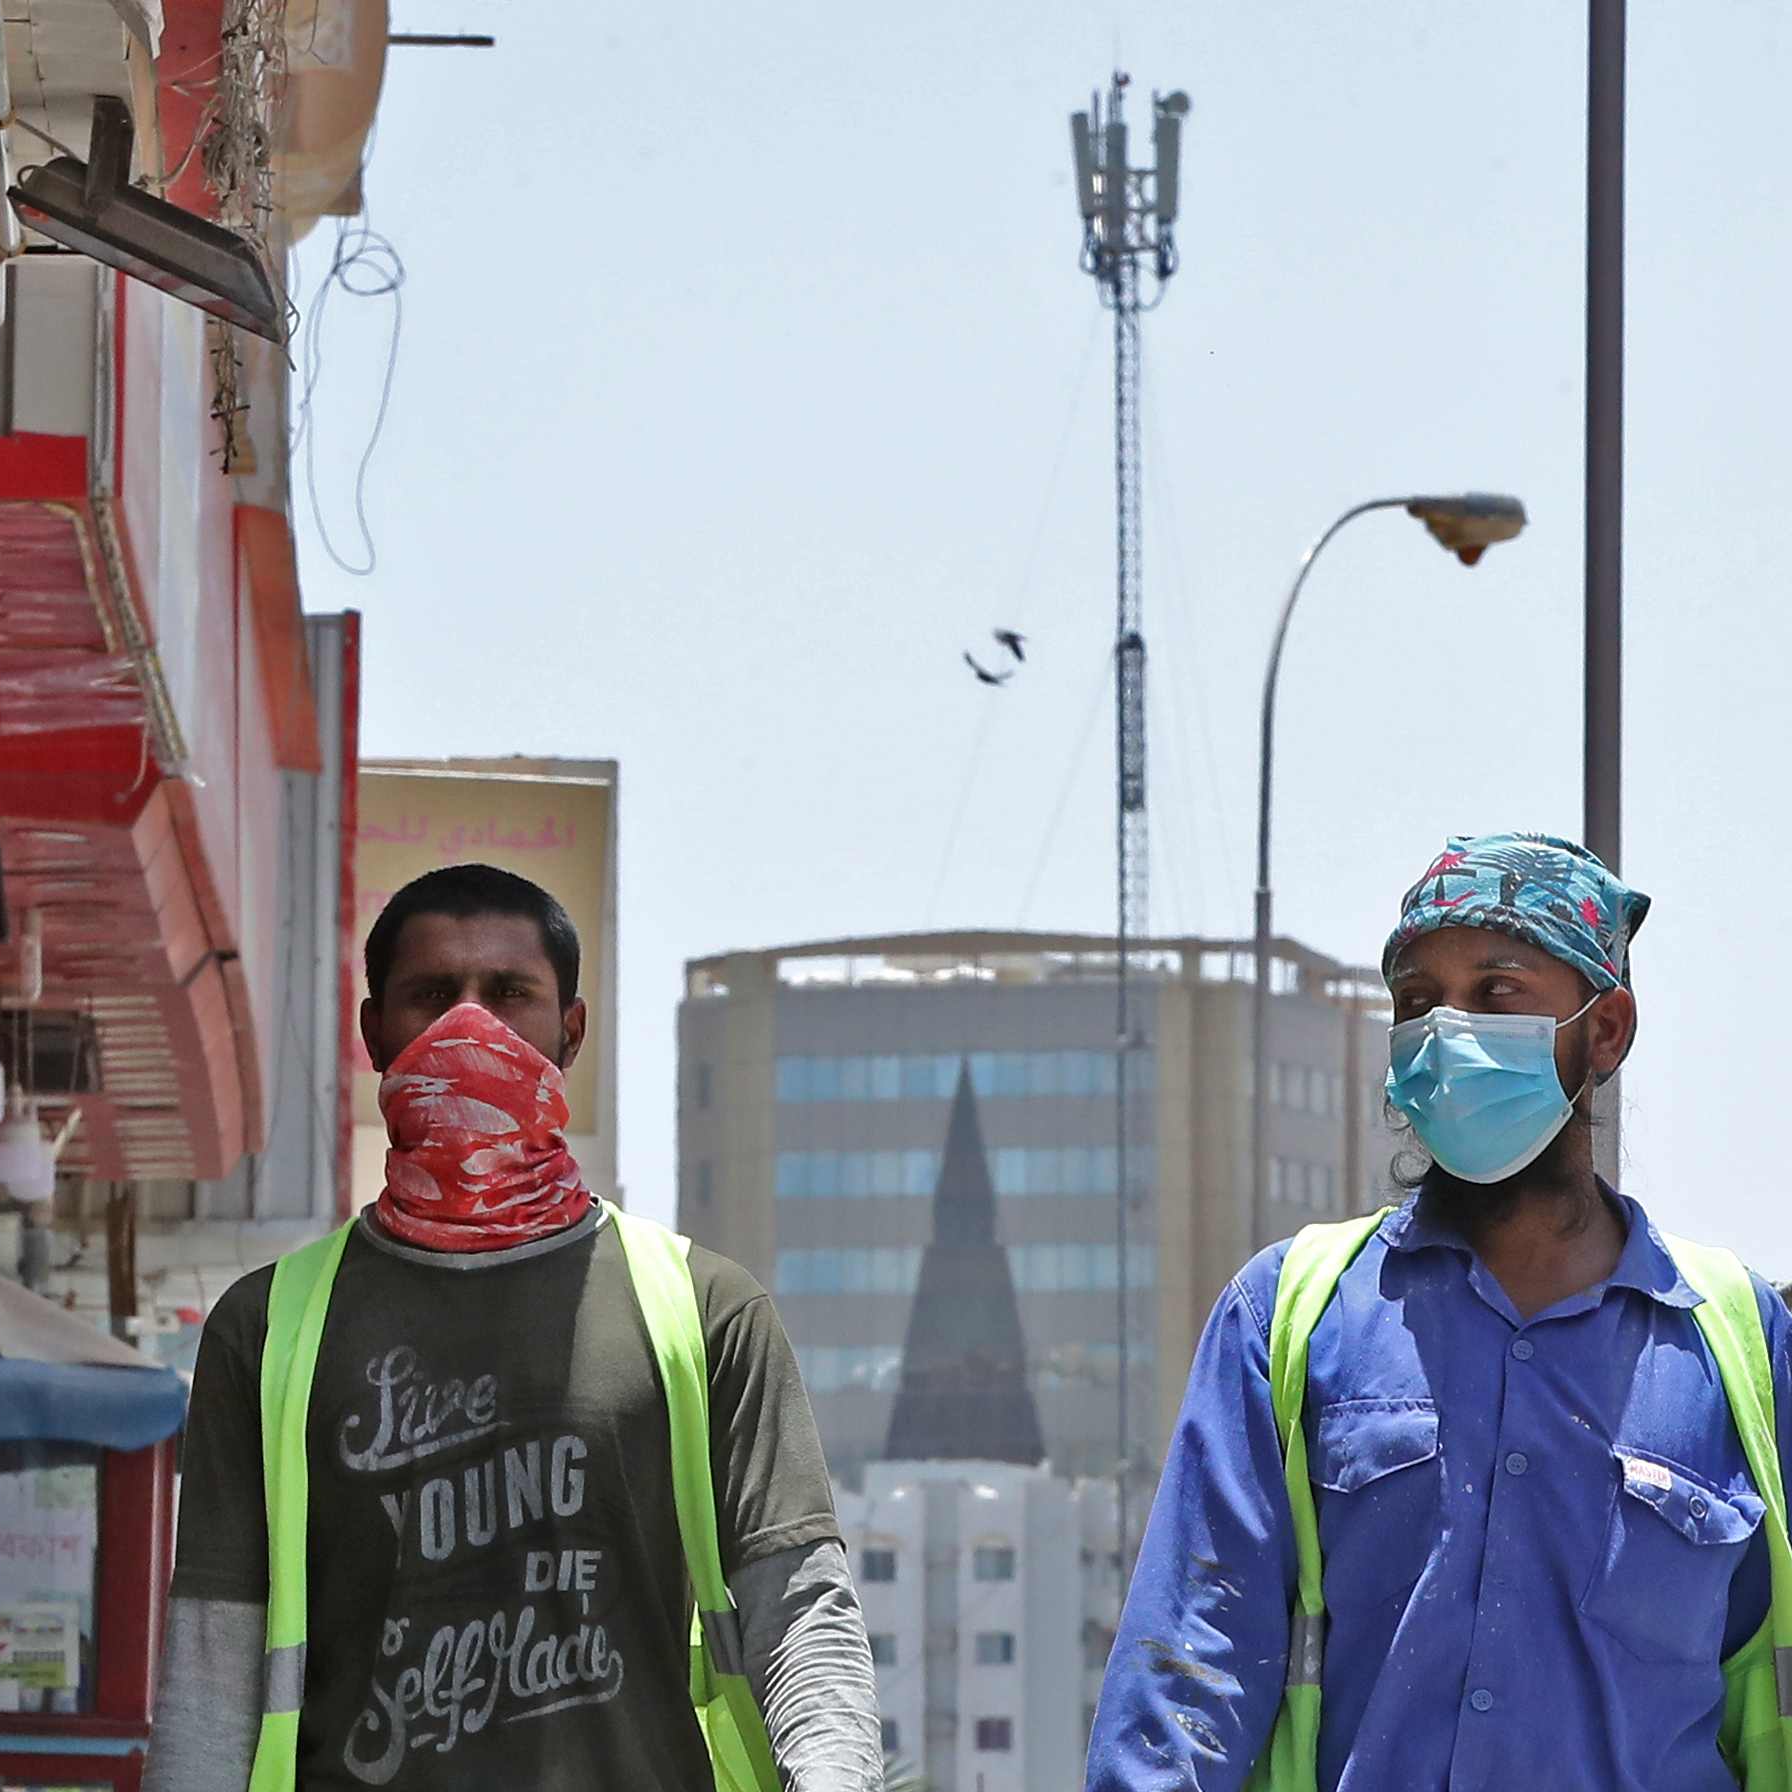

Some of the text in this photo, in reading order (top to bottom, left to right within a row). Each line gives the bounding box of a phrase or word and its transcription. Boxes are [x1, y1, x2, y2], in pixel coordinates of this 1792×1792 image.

[339, 1345, 508, 1471] Live
[380, 1435, 588, 1570] YOUNG
[524, 1550, 603, 1593] DIE
